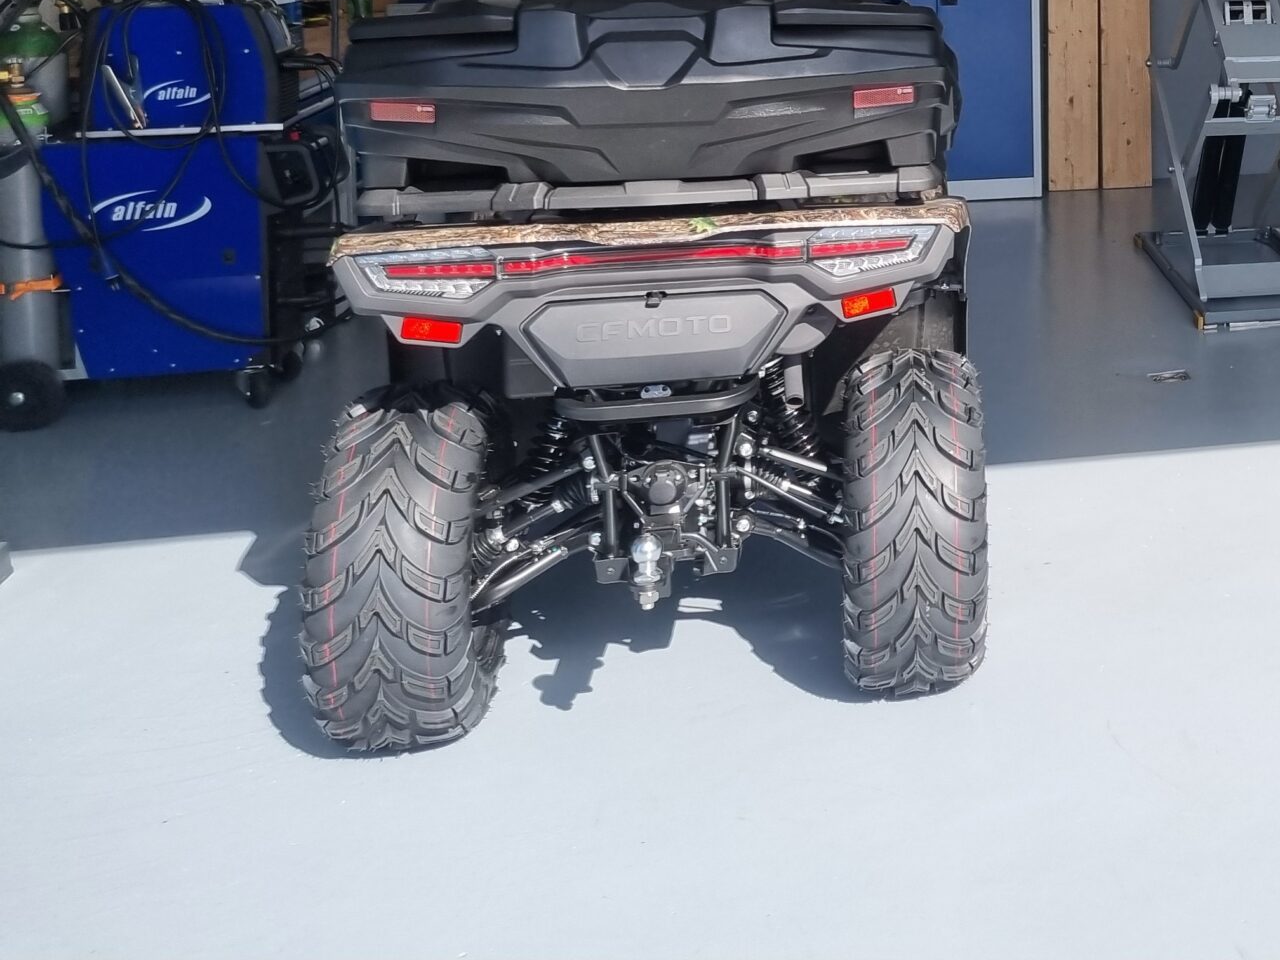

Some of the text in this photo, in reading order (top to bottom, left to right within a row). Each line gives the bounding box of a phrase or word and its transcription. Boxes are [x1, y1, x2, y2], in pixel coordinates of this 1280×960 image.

[157, 86, 197, 100] alfain
[112, 200, 177, 221] alfain
[576, 314, 732, 343] CFMOTO
